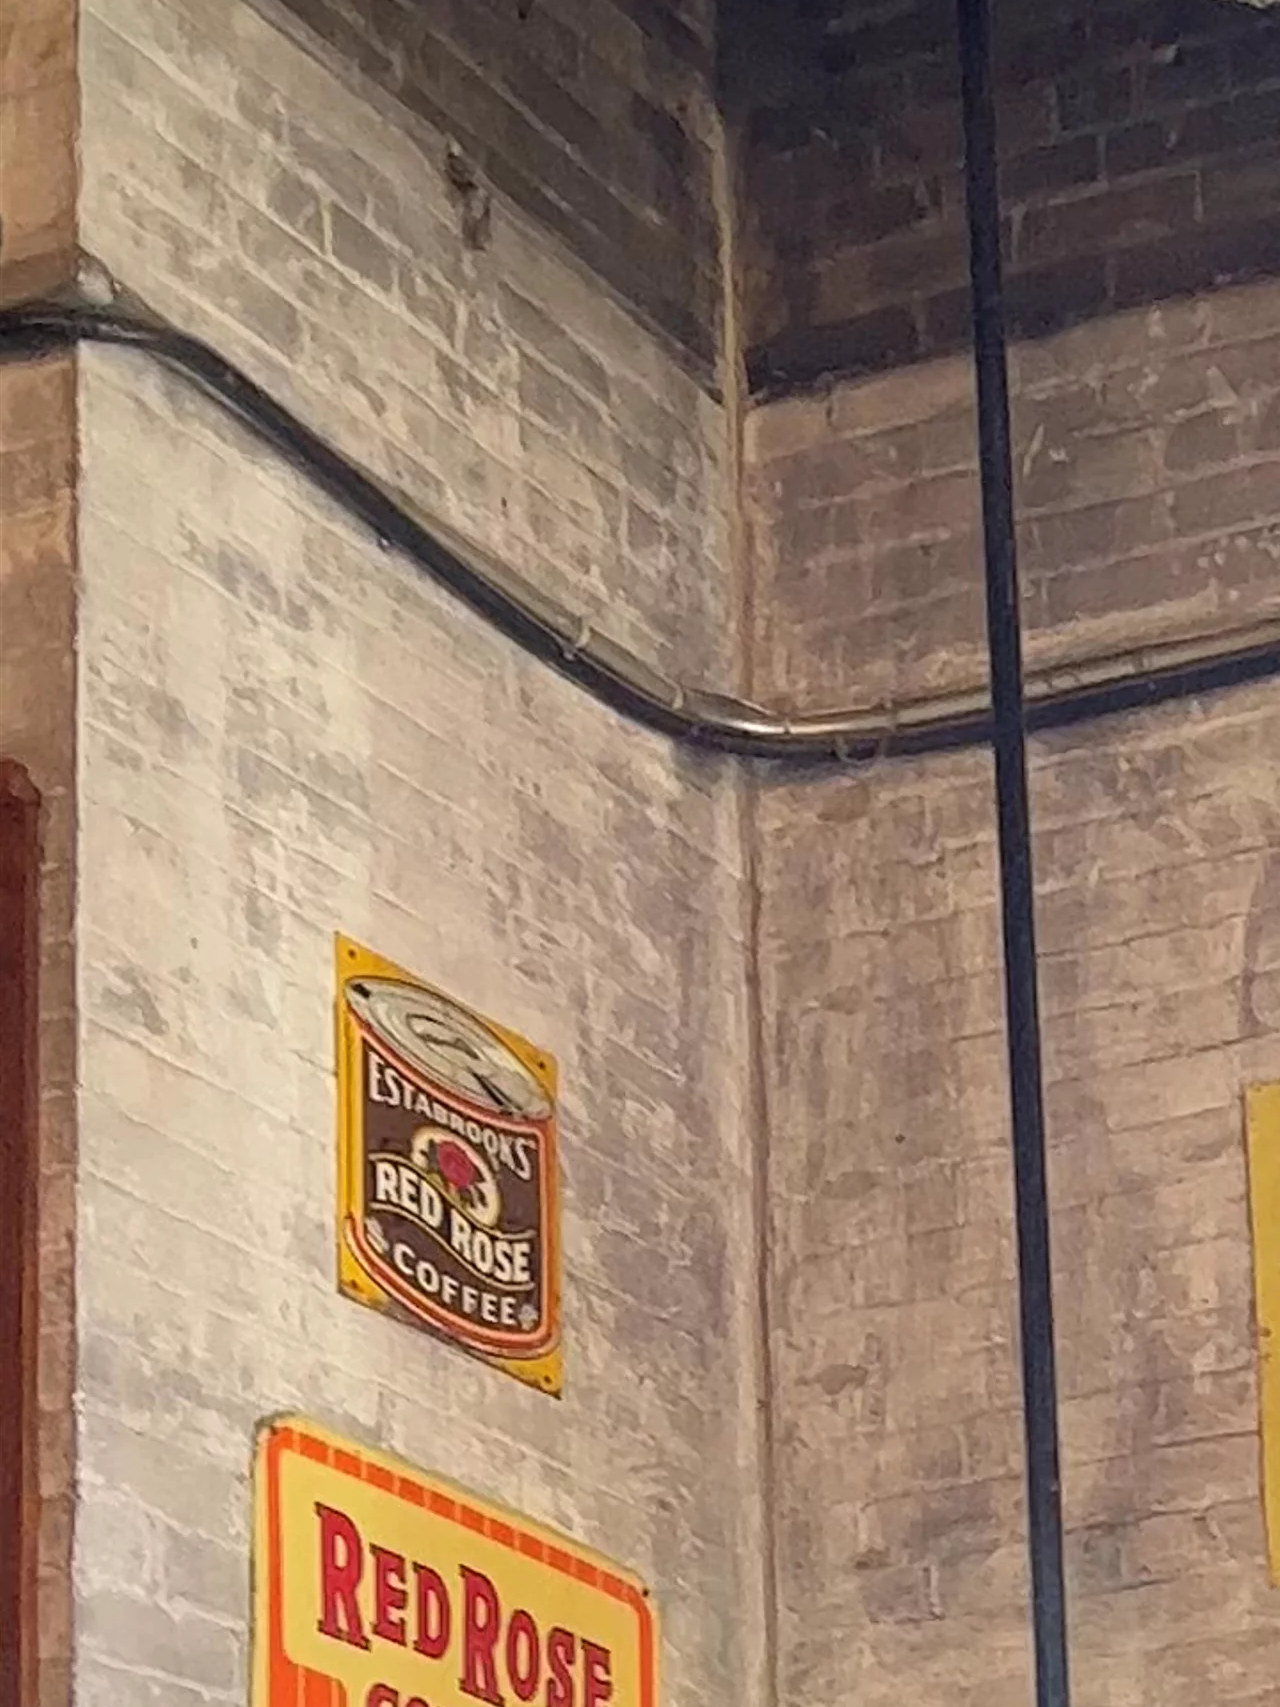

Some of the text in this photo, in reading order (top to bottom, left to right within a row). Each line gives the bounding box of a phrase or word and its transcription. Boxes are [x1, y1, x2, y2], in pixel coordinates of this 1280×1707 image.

[376, 1160, 532, 1283] RED ROSE
[393, 1242, 517, 1327] COFFEE
[315, 1501, 451, 1659] RED
